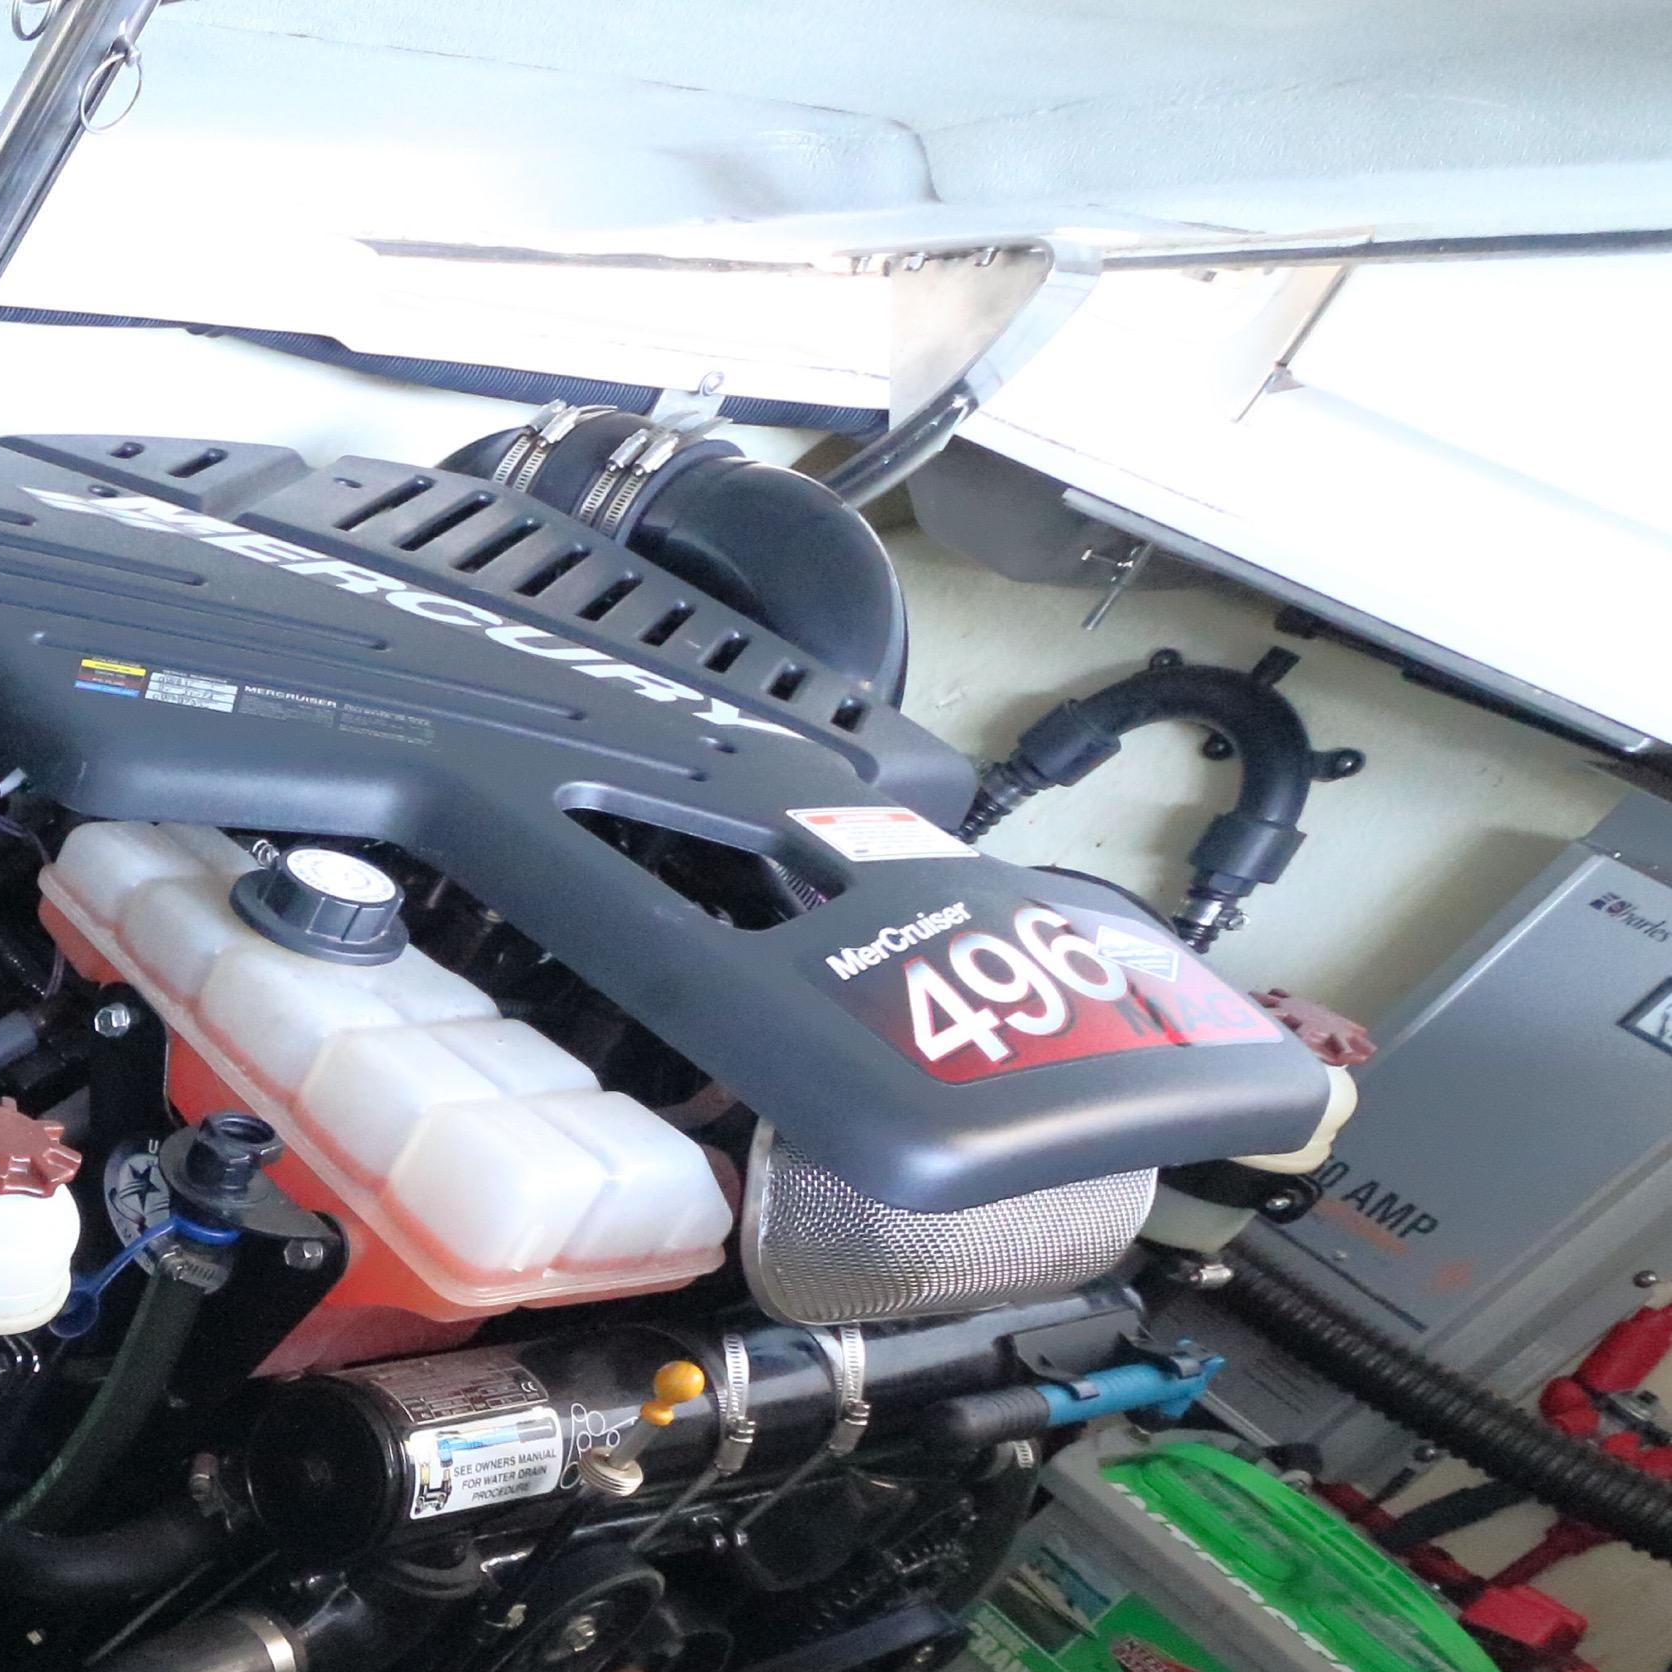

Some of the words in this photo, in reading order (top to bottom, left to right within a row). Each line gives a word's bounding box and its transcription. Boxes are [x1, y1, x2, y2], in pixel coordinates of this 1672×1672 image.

[127, 496, 806, 740] MERCURY
[244, 685, 337, 708] MERCRUISER
[825, 902, 972, 981] MerCruiser
[904, 907, 1127, 1062] 496
[1112, 982, 1257, 1037] MAG
[1341, 1180, 1439, 1238] AMP
[454, 1464, 472, 1477] SEE
[475, 1454, 516, 1472] OWNERS
[518, 1448, 557, 1463] MANUAL
[462, 1478, 481, 1489] FOR
[483, 1471, 515, 1486] WATER
[517, 1465, 547, 1479] DRAIN
[472, 1483, 529, 1501] PROCEDURE
